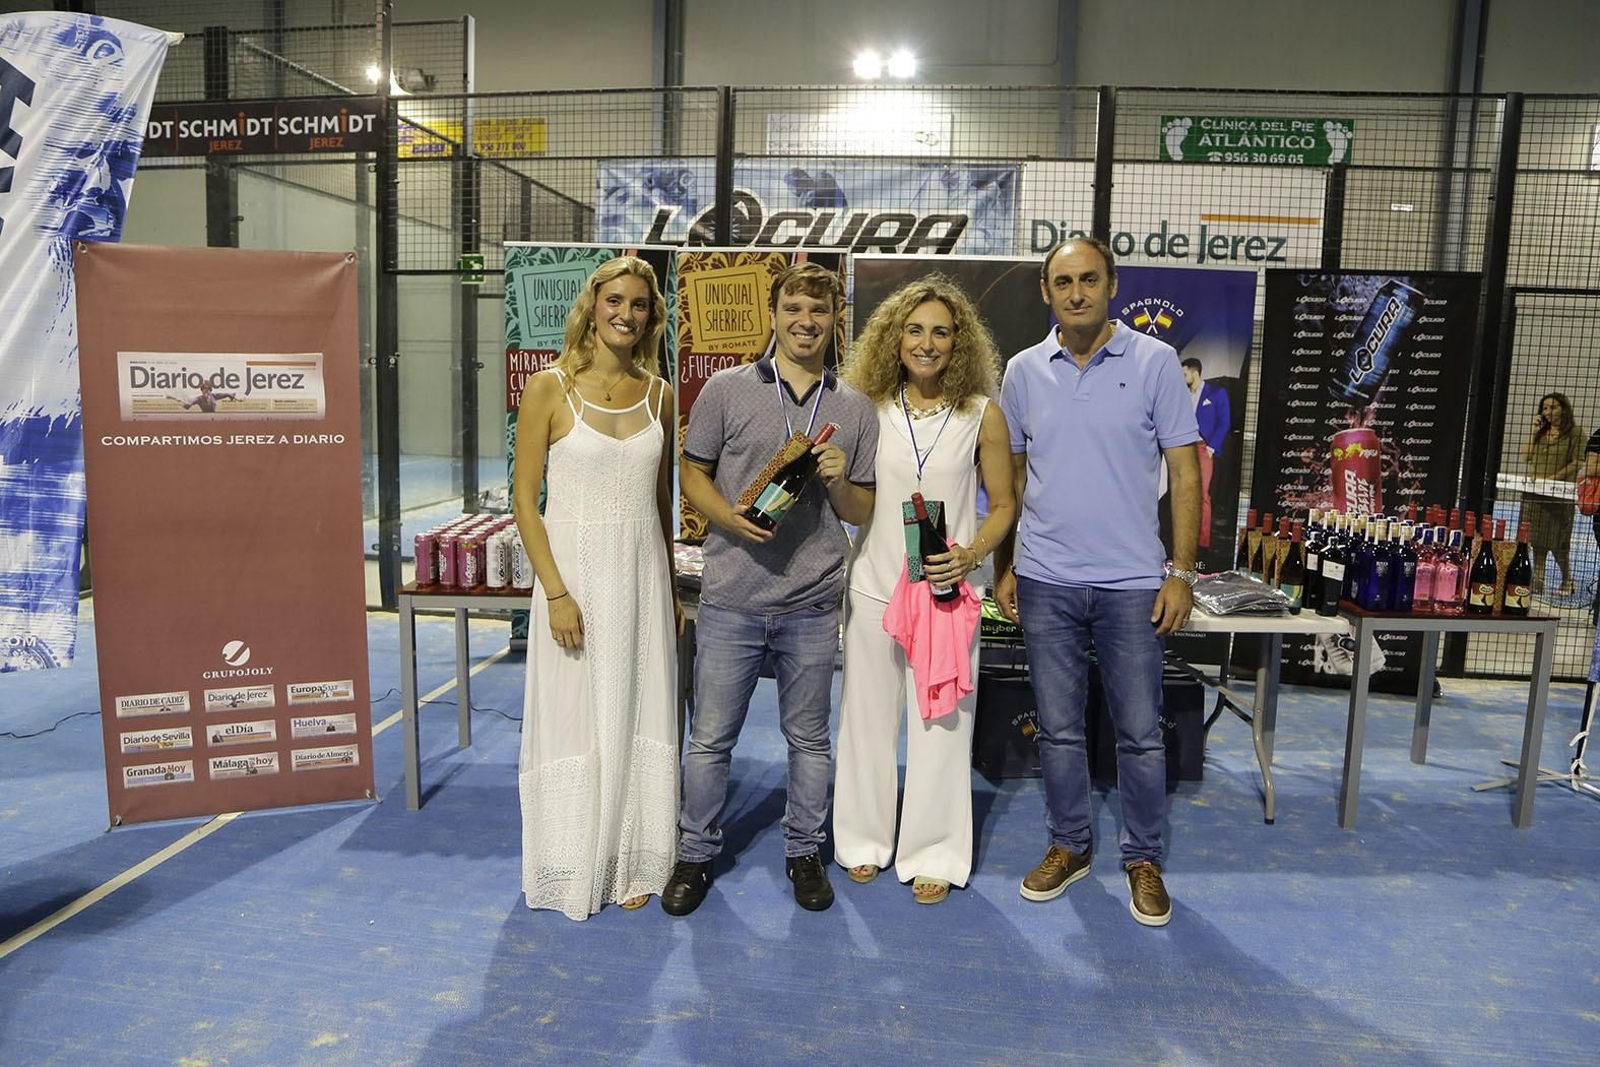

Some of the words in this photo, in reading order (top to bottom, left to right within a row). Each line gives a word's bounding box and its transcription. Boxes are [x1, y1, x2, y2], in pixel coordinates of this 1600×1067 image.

[1261, 121, 1286, 132] DEL
[1291, 121, 1316, 133] PIE
[209, 139, 244, 153] JEREZ
[309, 137, 345, 150] JEREZ
[1198, 131, 1316, 149] ATLÁNTICO
[1224, 151, 1249, 163] 956
[1252, 152, 1267, 164] 30
[1269, 153, 1286, 164] 69
[1288, 153, 1304, 164] 05
[1031, 219, 1135, 257] Dio
[1144, 219, 1189, 258] de
[1197, 224, 1286, 264] Jerez
[705, 283, 754, 306] UNUSUAL
[1121, 298, 1184, 318] SPAGNOLO
[533, 304, 571, 328] SHERR
[704, 309, 755, 332] SHERRIES
[708, 343, 719, 351] BY
[722, 340, 758, 349] ROMATE
[1348, 296, 1402, 385] LOCURA
[130, 365, 204, 389] Diario
[209, 367, 241, 389] de
[245, 367, 305, 397] Jerez
[101, 435, 223, 446] COMPARTIMOS
[226, 435, 276, 445] JEREZ
[278, 435, 289, 444] A
[293, 434, 345, 444] DIARIO
[121, 699, 149, 708] DIARIO
[150, 698, 160, 706] DE
[208, 692, 237, 702] Diario
[236, 690, 246, 699] de
[247, 690, 268, 701] Jerez
[293, 718, 327, 728] Huelva
[123, 736, 150, 745] Diario
[150, 735, 161, 743] de
[162, 732, 191, 743] Sevilla
[213, 758, 249, 770] Málaga
[256, 756, 274, 766] hoy
